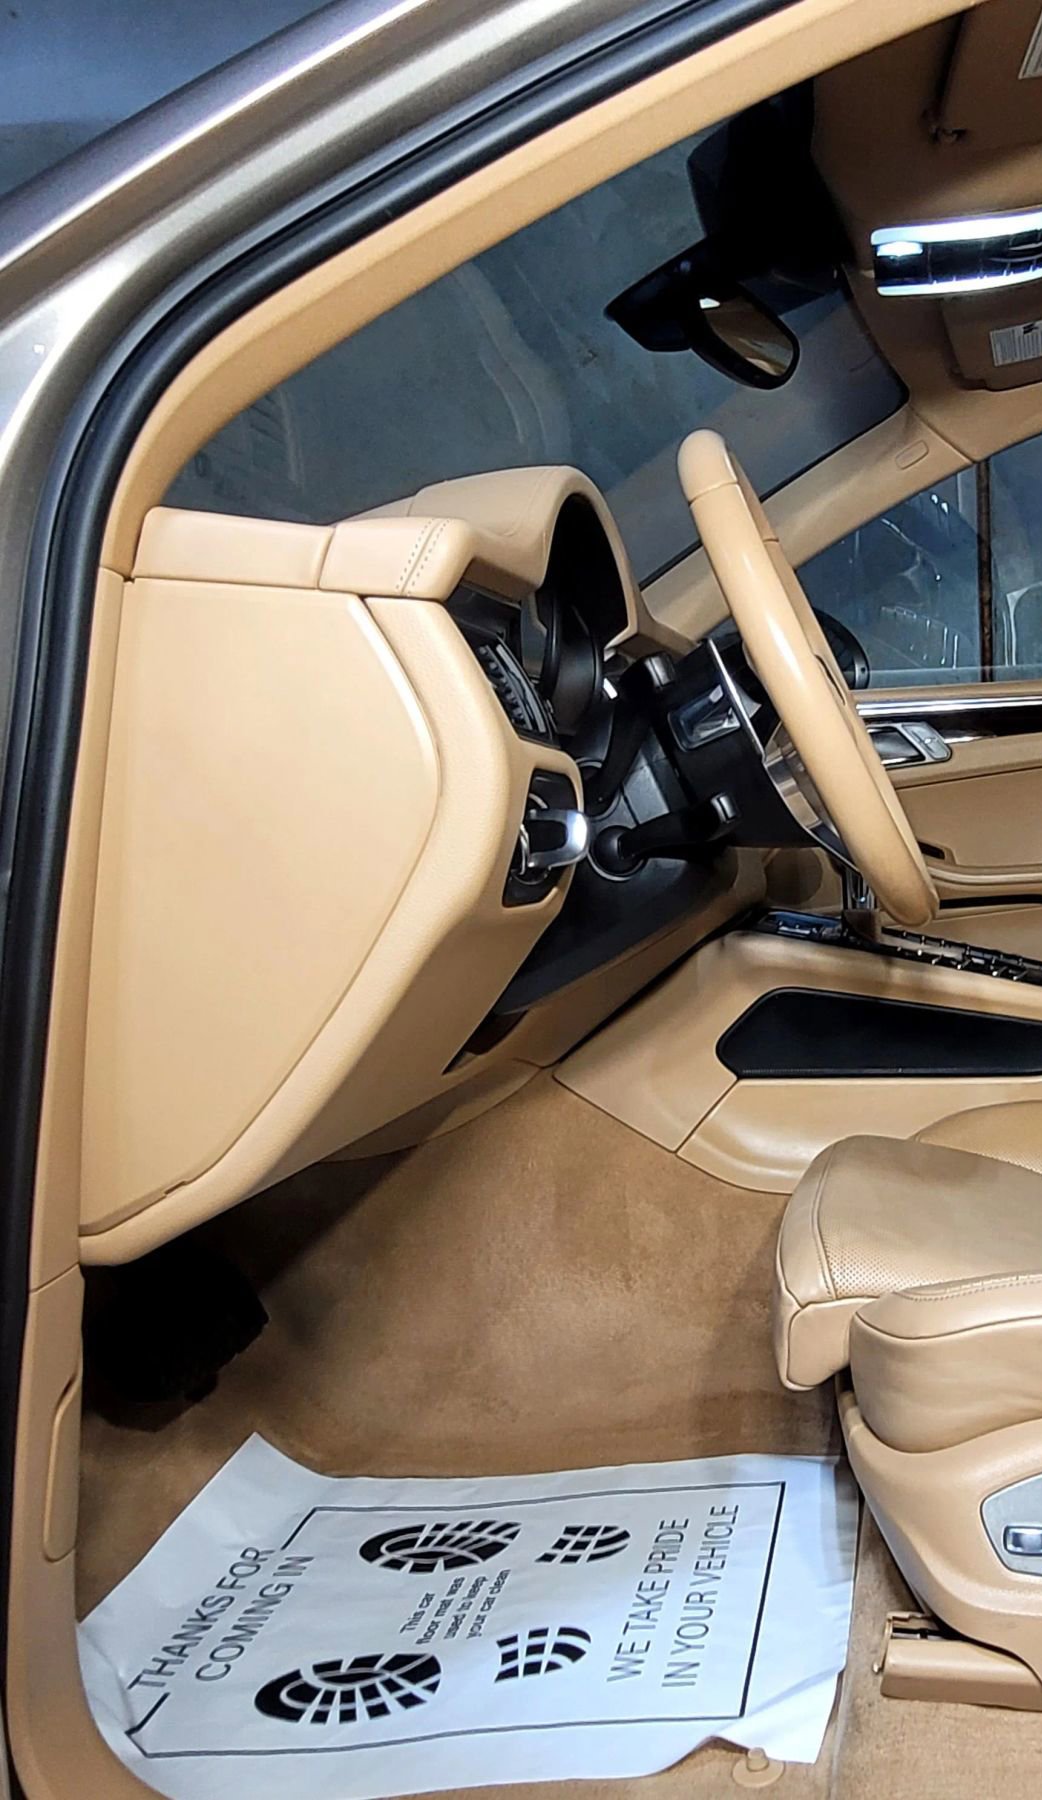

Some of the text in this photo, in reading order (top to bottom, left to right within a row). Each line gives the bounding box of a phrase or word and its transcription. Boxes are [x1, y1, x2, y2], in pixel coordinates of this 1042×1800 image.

[127, 1547, 275, 1690] THANKS FOR
[195, 1556, 315, 1682] COMING IN
[400, 1592, 436, 1634] This car
[415, 1577, 466, 1645] floor mat was
[443, 1576, 489, 1640] used to keep
[466, 1569, 511, 1640] your car clean
[606, 1518, 690, 1682] WE TAKE PRIDE
[661, 1504, 740, 1687] IN YOUR VEHICLE
